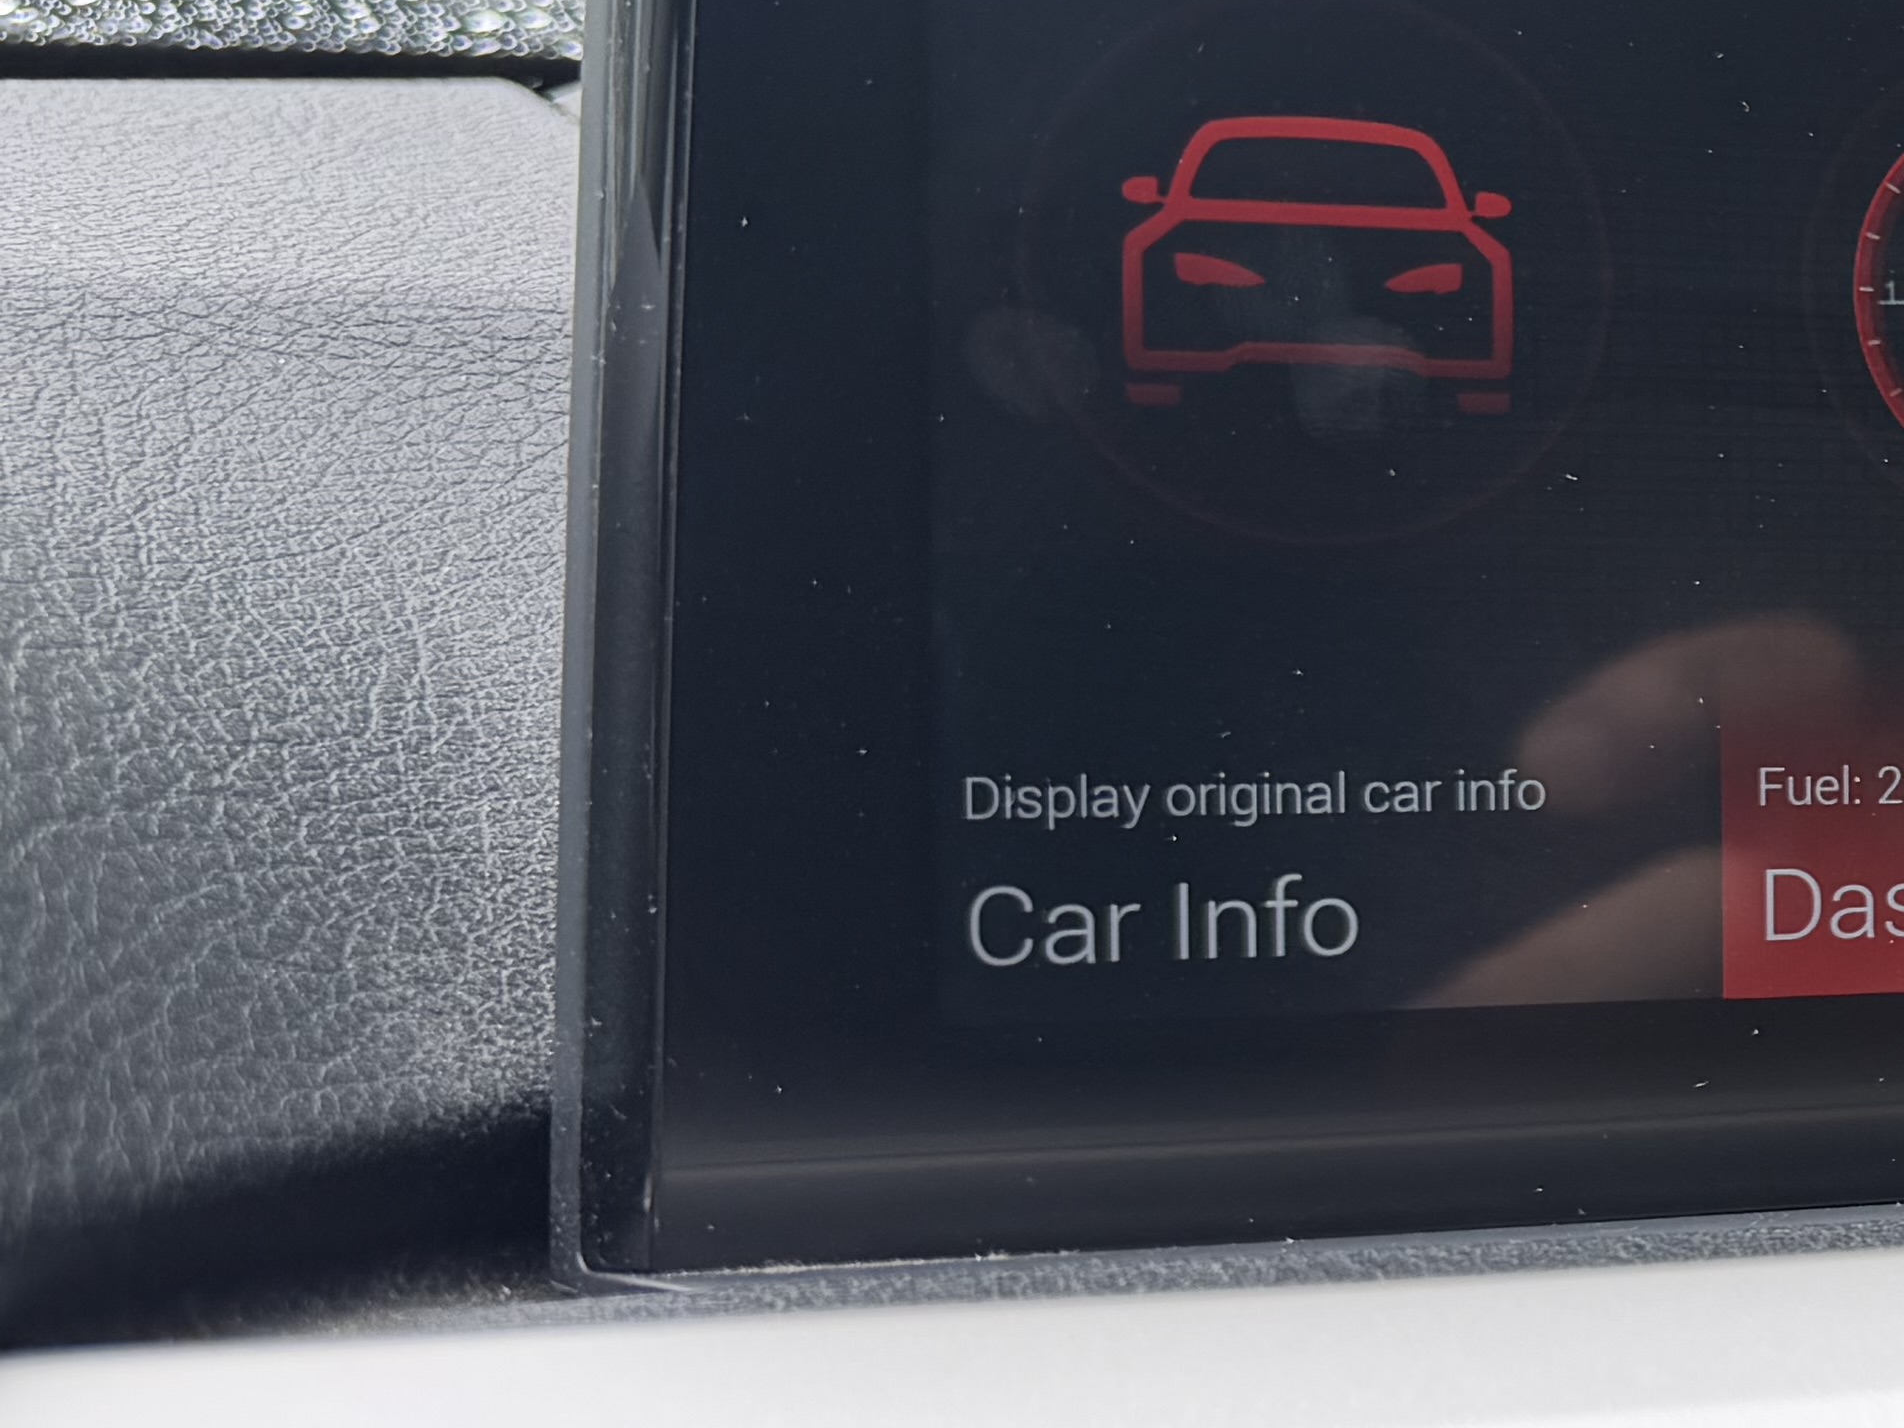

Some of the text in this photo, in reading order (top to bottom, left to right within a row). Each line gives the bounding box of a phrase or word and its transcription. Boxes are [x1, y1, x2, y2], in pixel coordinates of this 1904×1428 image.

[1885, 280, 1898, 303] 1
[963, 768, 1548, 830] Display original car info
[1758, 764, 1862, 808] Fuel:
[968, 872, 1360, 968] Car Info
